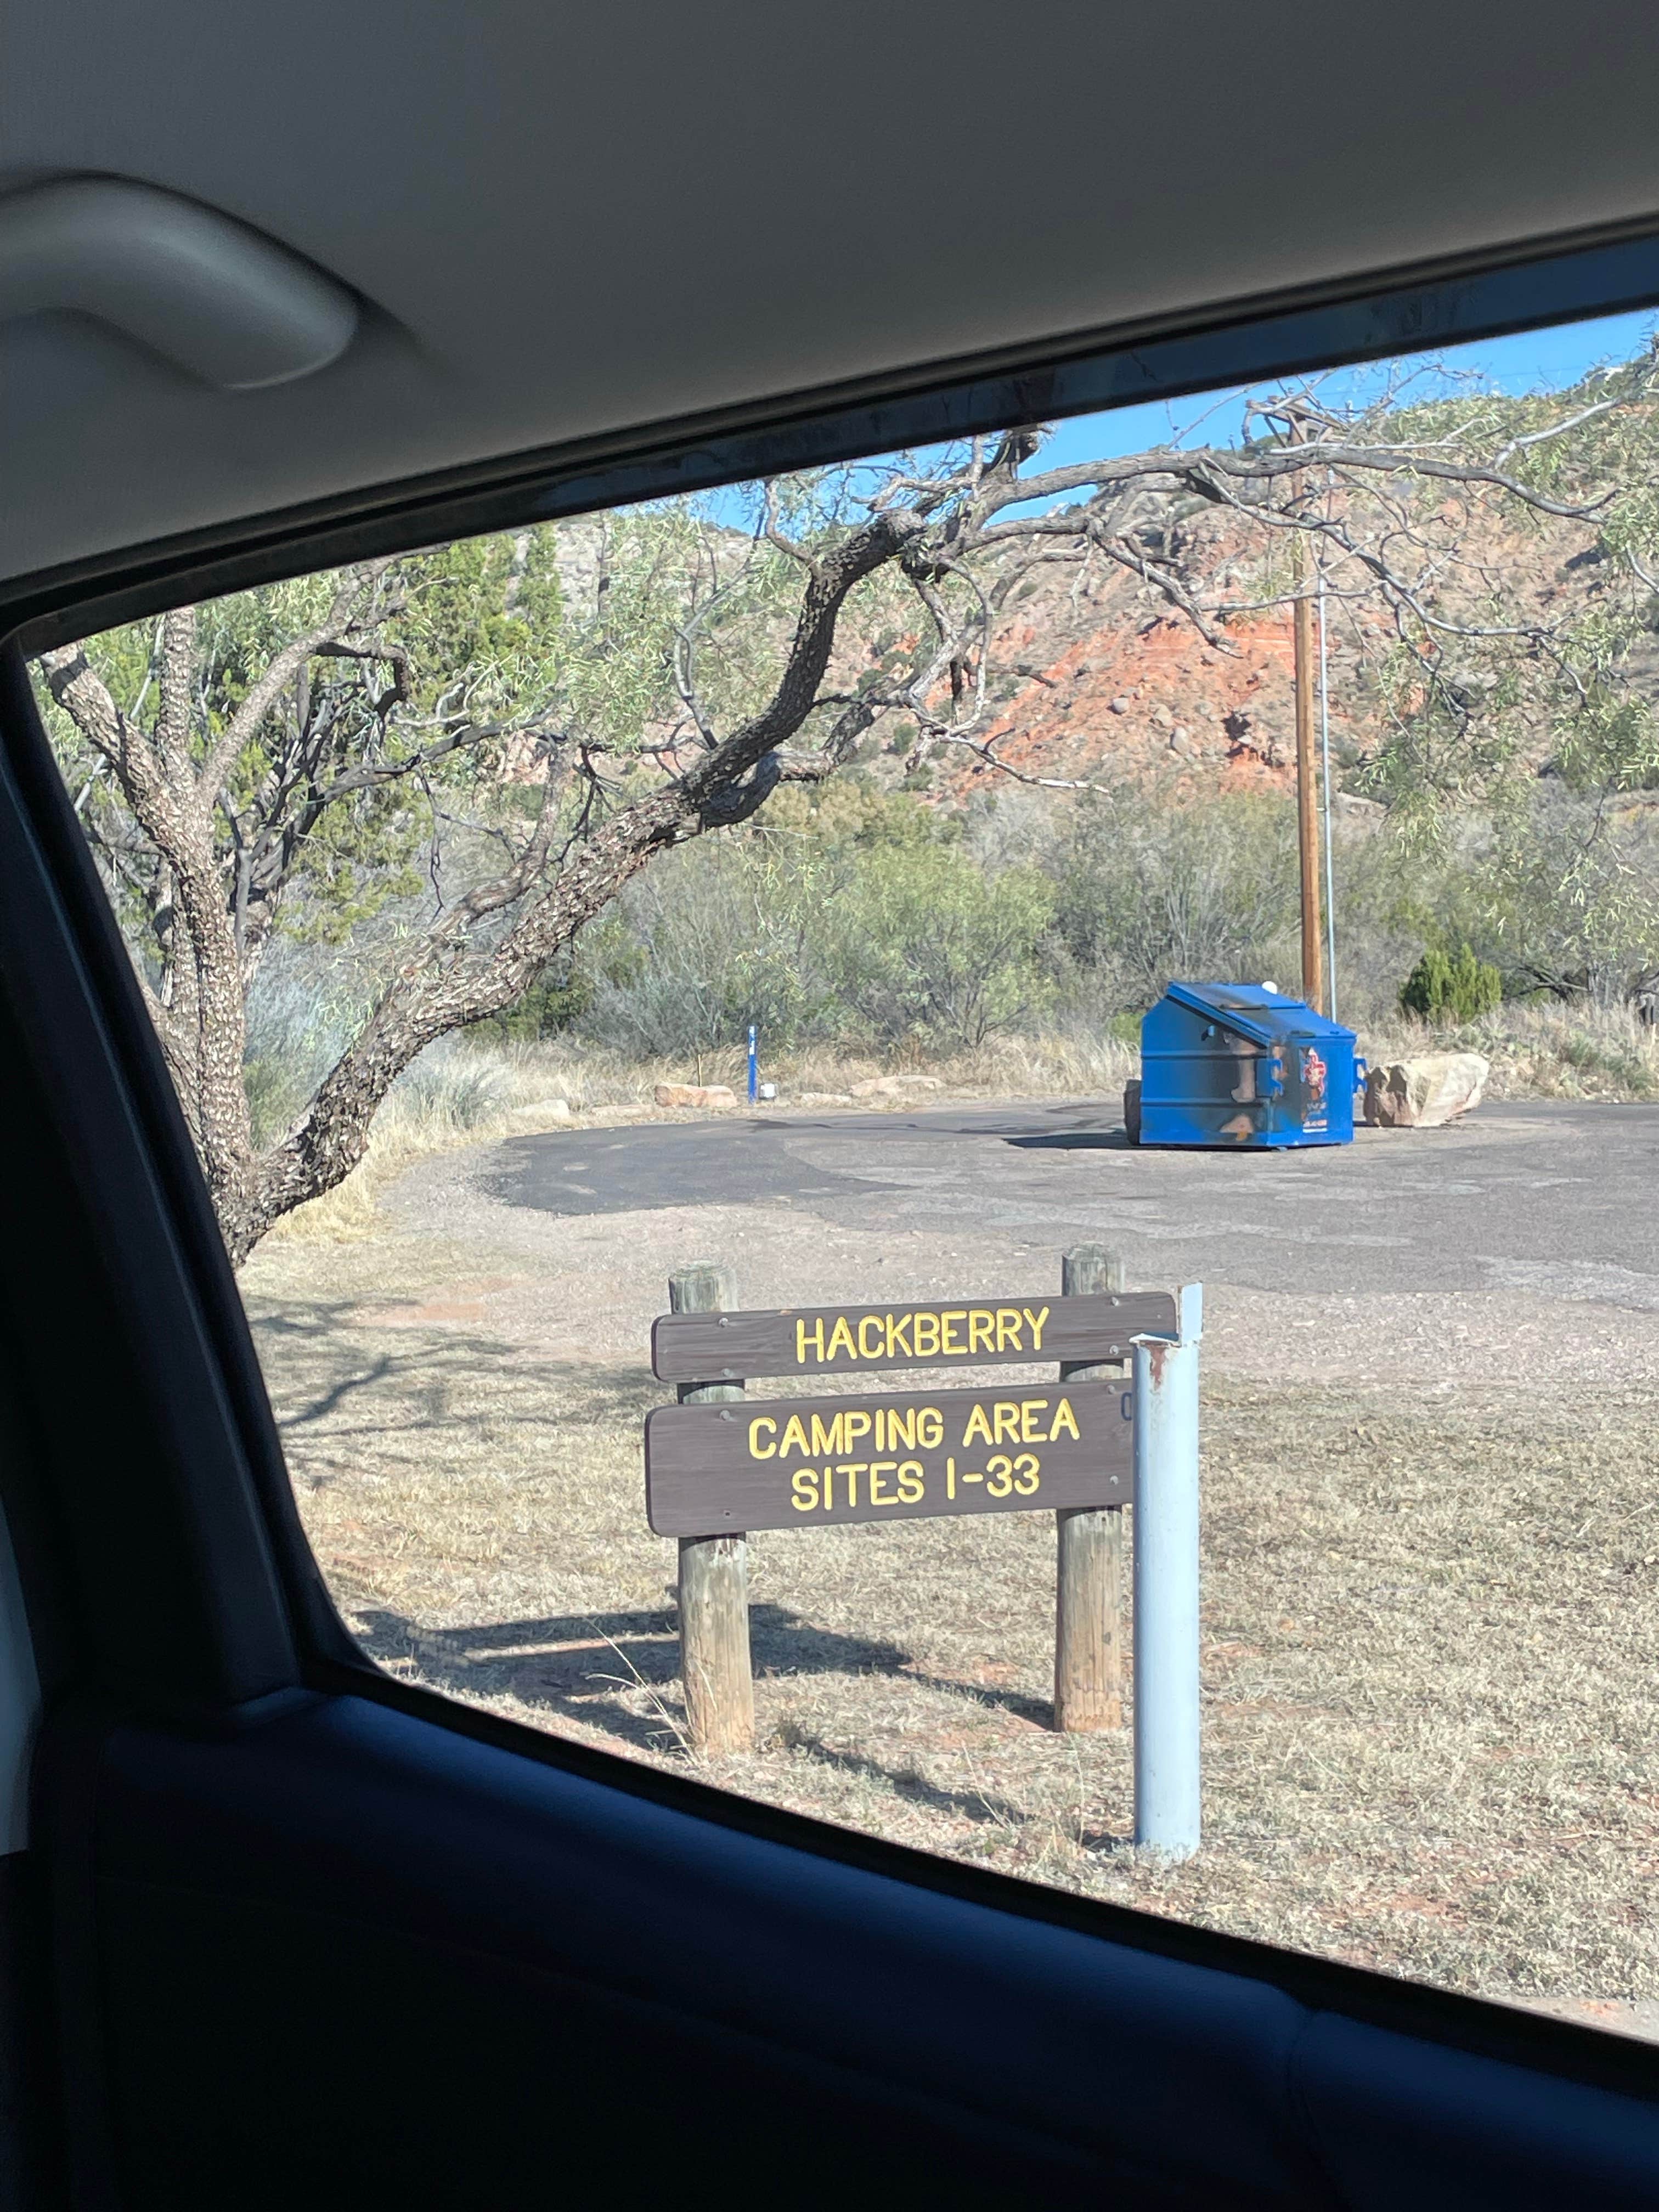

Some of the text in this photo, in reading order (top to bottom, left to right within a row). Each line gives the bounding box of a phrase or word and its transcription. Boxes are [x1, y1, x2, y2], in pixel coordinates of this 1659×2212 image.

[795, 1306, 1049, 1363] HACKBERRY
[748, 1398, 1080, 1459] CAMPING AREA
[791, 1453, 1040, 1511] SITES 1-33
